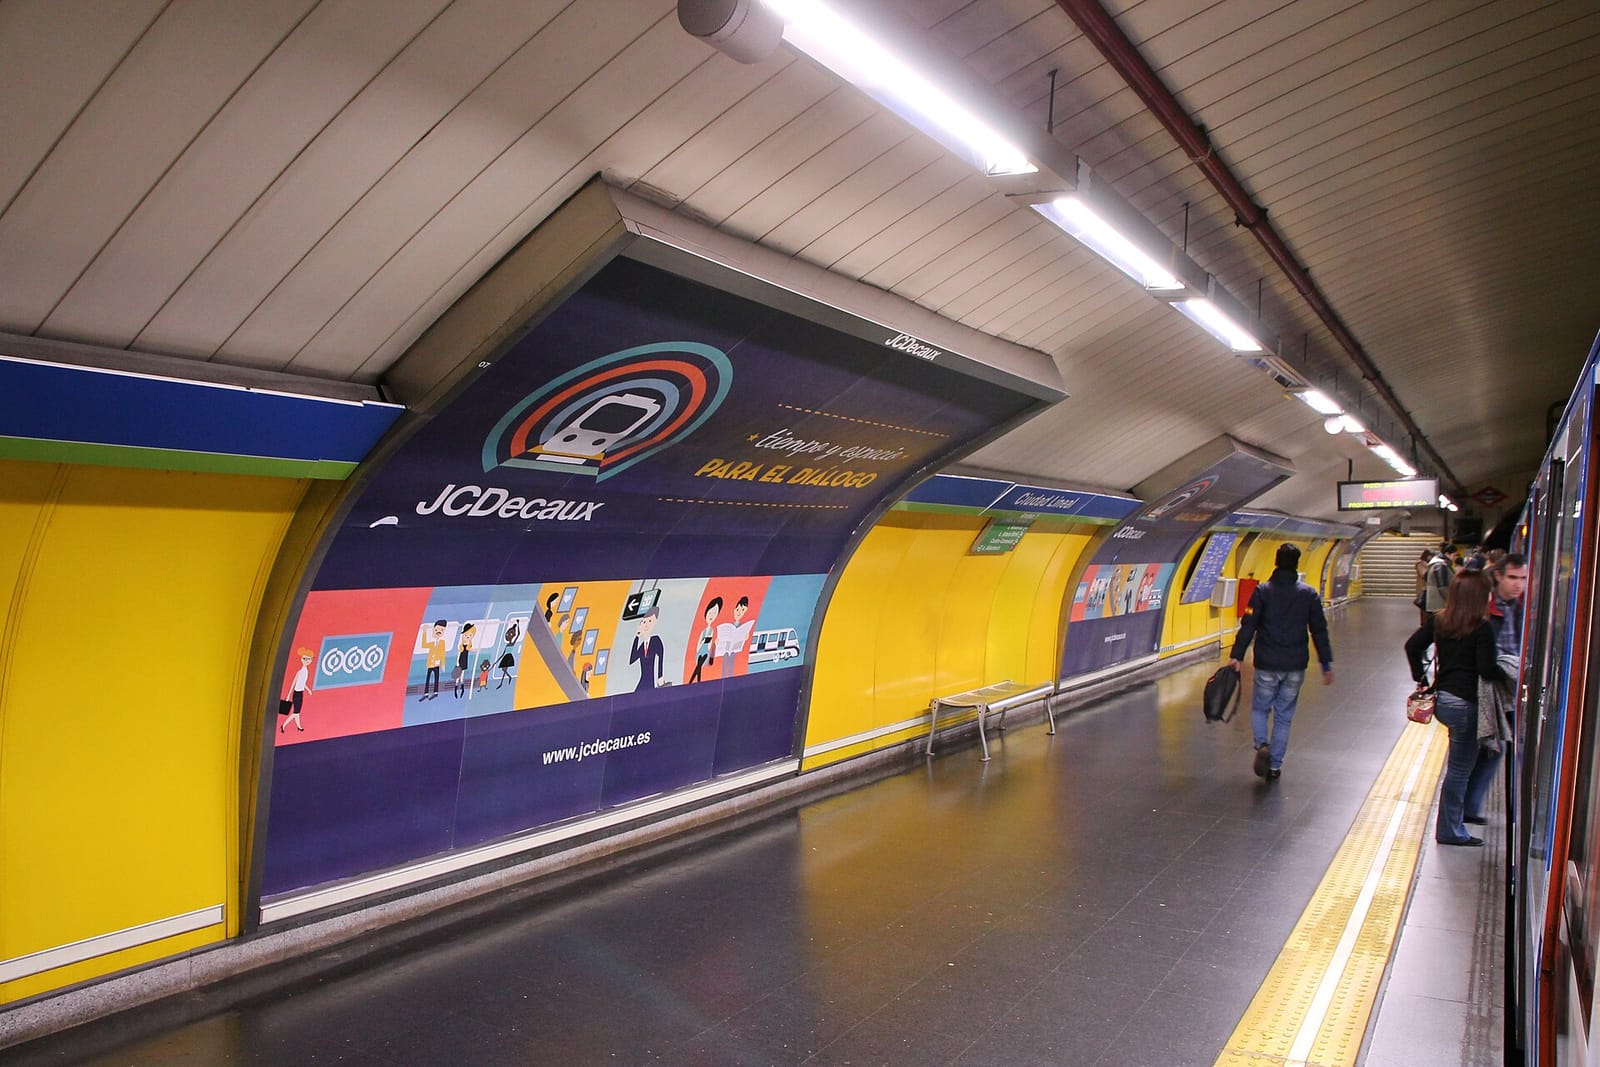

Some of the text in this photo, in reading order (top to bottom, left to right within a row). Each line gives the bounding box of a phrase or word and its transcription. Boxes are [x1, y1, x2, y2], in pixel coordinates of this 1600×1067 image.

[884, 333, 942, 361] JCDecaux
[478, 361, 491, 369] 07
[754, 428, 905, 464] tiempo y espacio
[694, 458, 878, 489] PARA EL DIÁLOGO
[415, 484, 605, 521] JCDecaux
[1014, 492, 1081, 509] Ciudad Lineal
[542, 731, 651, 765] www.jcdecaux.es
